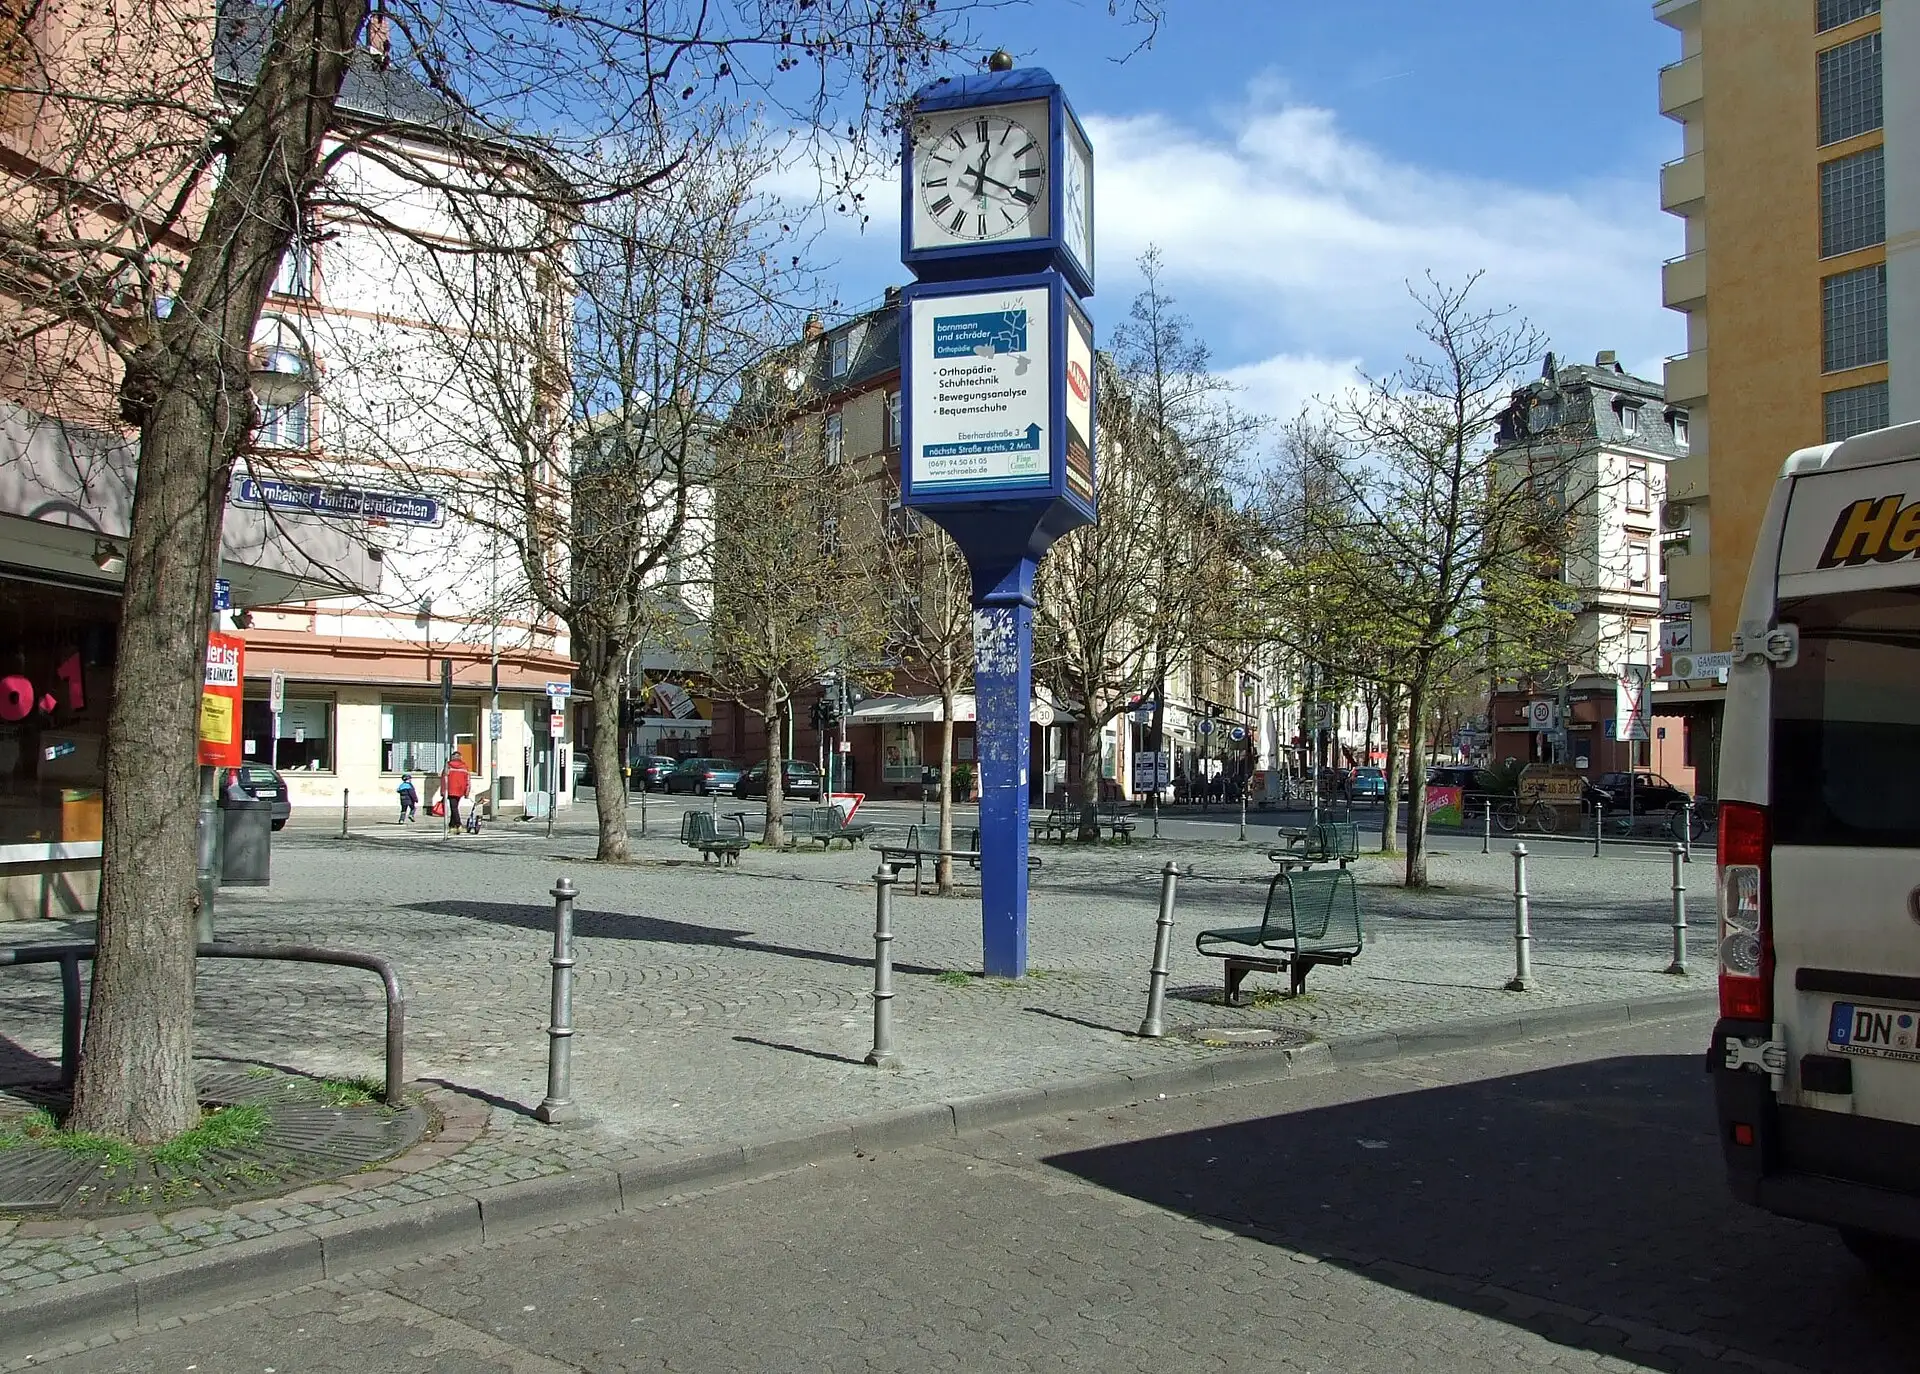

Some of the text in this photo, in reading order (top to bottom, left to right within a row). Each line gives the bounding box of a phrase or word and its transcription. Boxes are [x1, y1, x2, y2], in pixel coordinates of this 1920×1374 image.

[937, 322, 978, 332] bornmann
[937, 331, 991, 341] und schröder
[937, 345, 971, 354] Orthopädie
[939, 364, 997, 377] Orthopädie-
[939, 375, 999, 388] Schuhtechnik
[939, 388, 1027, 403] Bewegungsanalyse
[939, 403, 1007, 416] Bequemschuhe
[958, 430, 1013, 440] Eberhardstraße
[929, 447, 957, 456] nächste
[958, 445, 982, 454] Straße
[983, 443, 1008, 453] rechts,
[1016, 441, 1033, 450] Min.
[928, 457, 987, 469] (069) 94 50 61 05
[929, 466, 988, 476] www.schroebo.de
[1817, 493, 1920, 569] He
[206, 640, 223, 662] ier
[1039, 710, 1050, 720] 30
[1537, 707, 1547, 716] 30
[1853, 1011, 1892, 1045] DN
[1839, 1045, 1878, 1056] SCHOLZ
